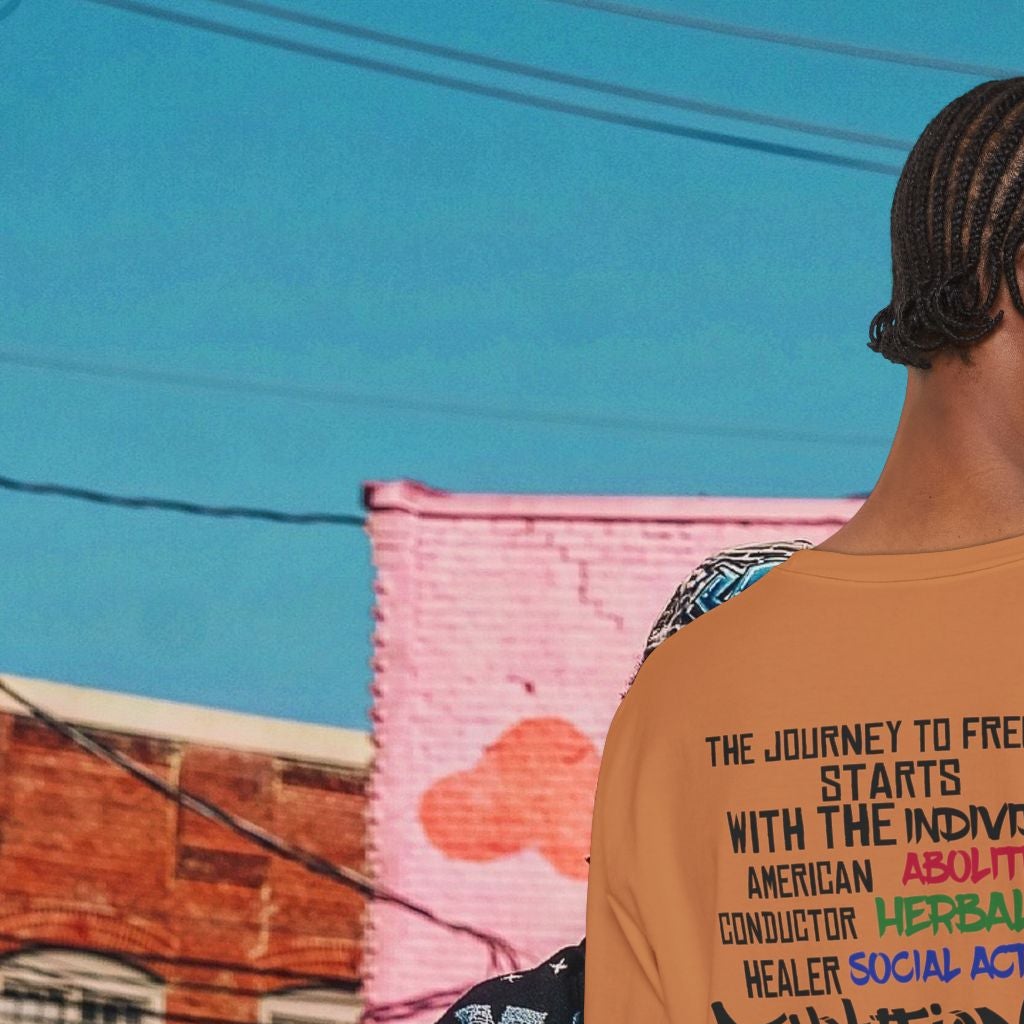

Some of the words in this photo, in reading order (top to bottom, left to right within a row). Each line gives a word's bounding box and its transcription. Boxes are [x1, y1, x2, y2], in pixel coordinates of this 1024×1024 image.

[705, 734, 755, 768] THE
[764, 720, 902, 762] JOURNEY
[913, 718, 951, 753] TO
[820, 758, 961, 802] STARTS
[726, 808, 805, 854] WITH
[816, 803, 897, 849] THE
[748, 860, 874, 899] AMERICAN
[718, 907, 858, 945] CONDUCTOR
[743, 957, 842, 999] HEALER
[848, 948, 962, 986] SOCIAL
